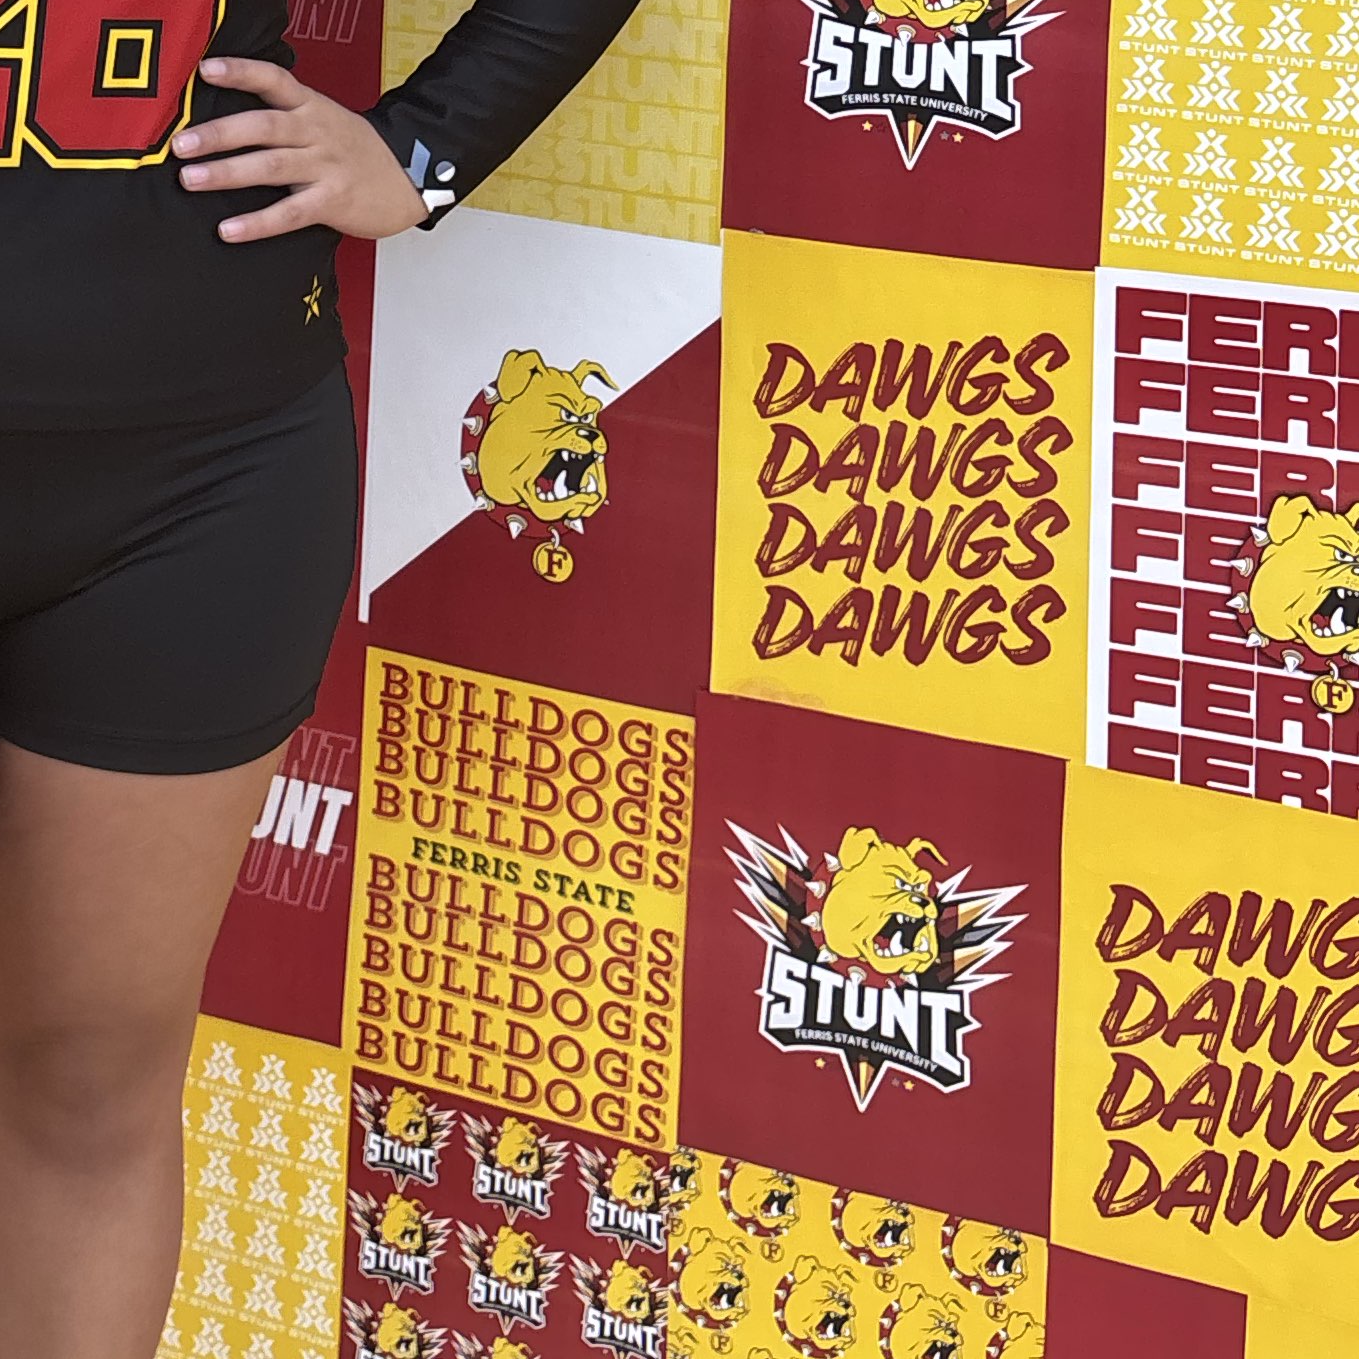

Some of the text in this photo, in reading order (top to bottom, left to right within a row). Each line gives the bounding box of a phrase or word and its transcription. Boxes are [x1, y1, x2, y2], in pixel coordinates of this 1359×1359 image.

[814, 19, 1012, 121] STUNT
[842, 93, 988, 121] FERRIS STATE UNIVERSITY
[753, 333, 1070, 420] DAWGS
[757, 418, 1072, 499] DAWGS
[543, 551, 568, 578] F
[755, 497, 1069, 581] DAWGS
[752, 584, 1067, 667] DAWGS
[381, 662, 692, 771] BULLDOGS
[1323, 683, 1347, 708] F
[376, 740, 686, 845] BULLDOGS
[379, 701, 688, 808] BULLDOGS
[372, 780, 683, 891] BULLDOGS
[412, 837, 634, 914] FERRIS STATE
[364, 894, 674, 1008] BULLDOGS
[368, 854, 676, 970] BULLDOGS
[1095, 884, 1359, 980] DAWG
[359, 979, 667, 1101] BULLDOGS
[362, 934, 672, 1054] BULLDOGS
[768, 950, 961, 1077] STUNT
[1099, 968, 1359, 1067] DAWG
[356, 1020, 666, 1146] BULLDOGS
[795, 1028, 938, 1072] FERRIS STATE UNIVERSITY
[1096, 1052, 1359, 1153] DAWG
[1092, 1139, 1359, 1242] DAWG
